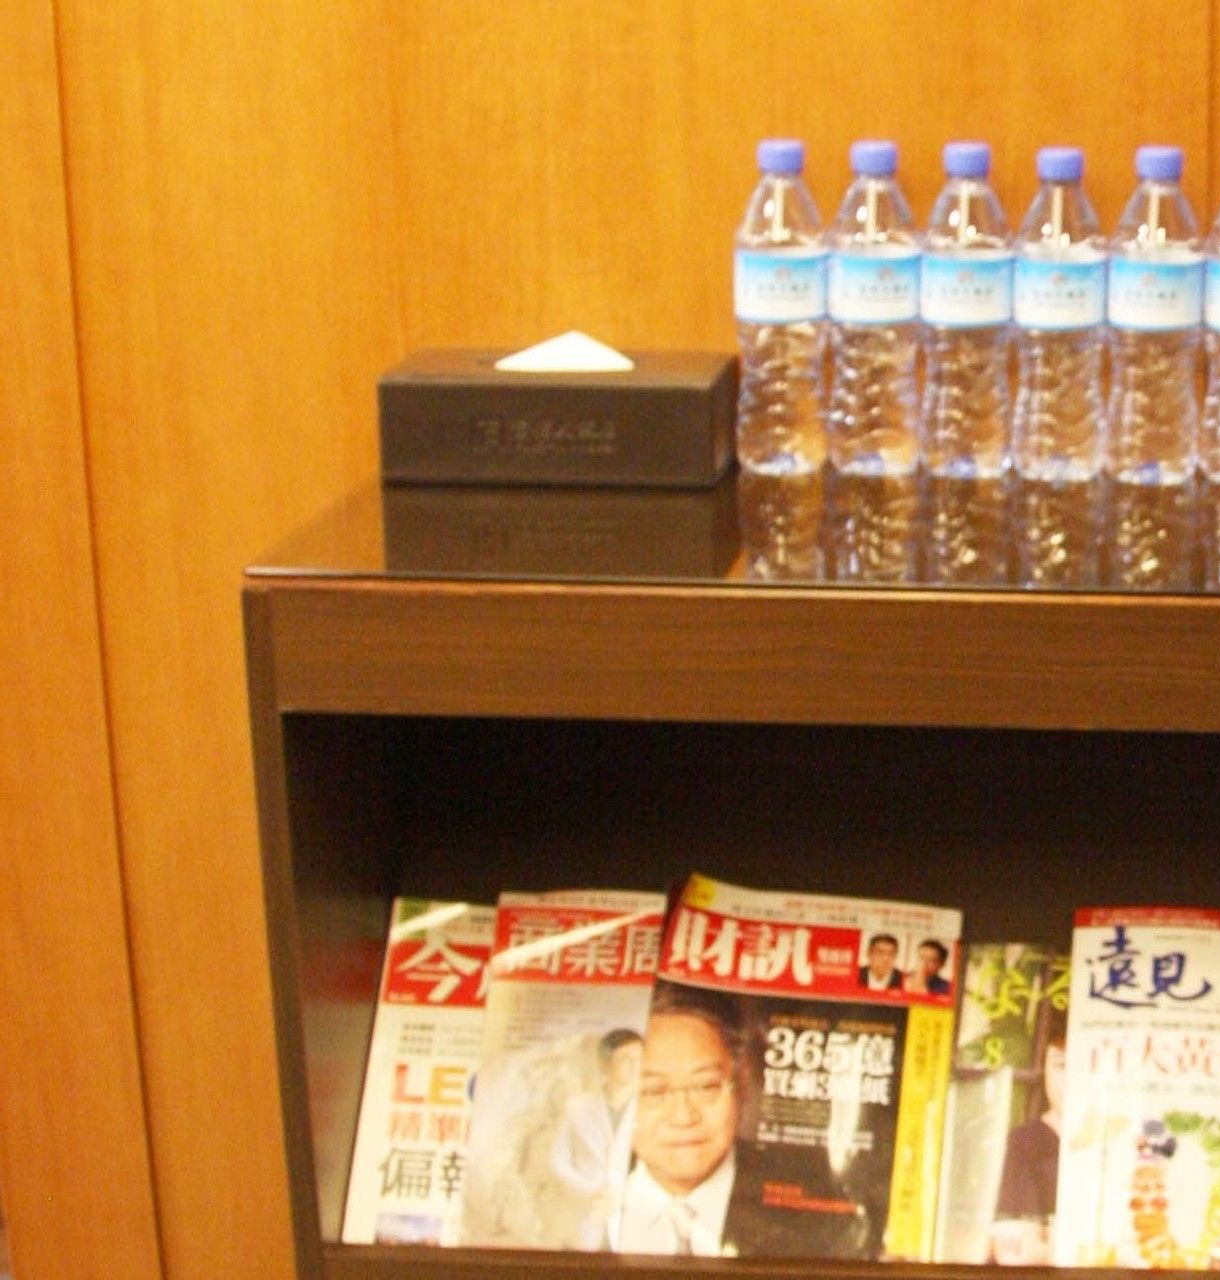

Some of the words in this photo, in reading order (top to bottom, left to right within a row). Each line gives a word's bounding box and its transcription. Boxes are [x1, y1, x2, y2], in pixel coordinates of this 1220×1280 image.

[393, 928, 489, 1003] 今
[667, 906, 815, 986] 財訊
[1086, 924, 1212, 1009] 遠見
[391, 1062, 478, 1106] LE
